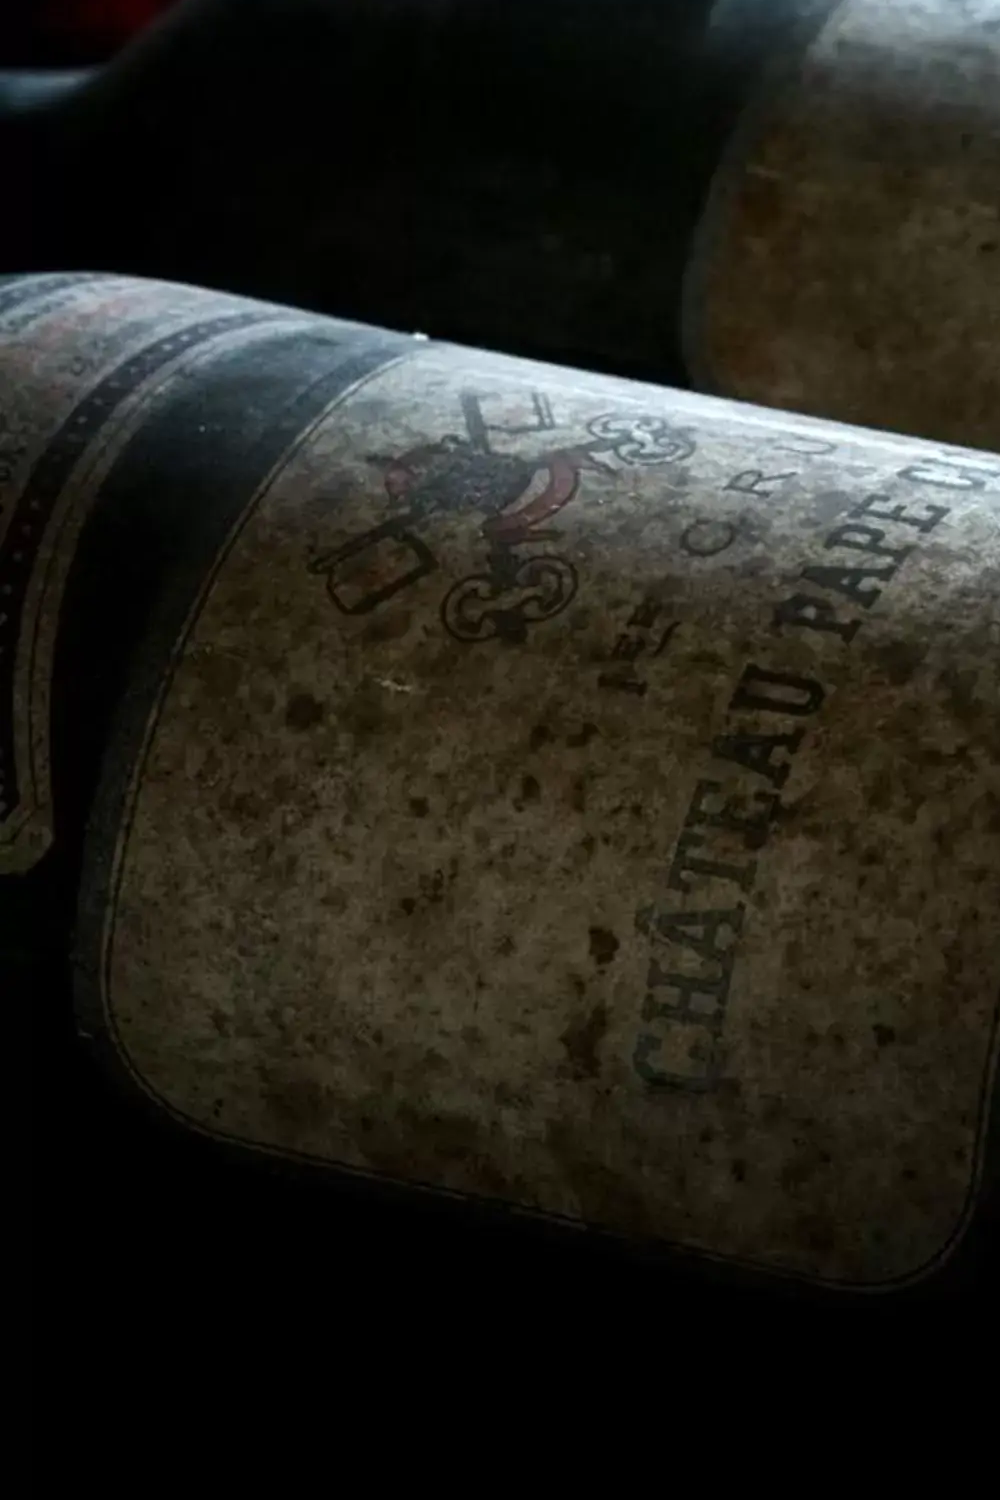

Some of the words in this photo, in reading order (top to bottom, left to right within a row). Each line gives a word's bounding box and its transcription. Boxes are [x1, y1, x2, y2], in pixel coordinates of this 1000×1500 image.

[680, 436, 838, 558] CRU
[631, 664, 826, 1094] CHÂTEAU
[768, 493, 951, 644] PAPE
